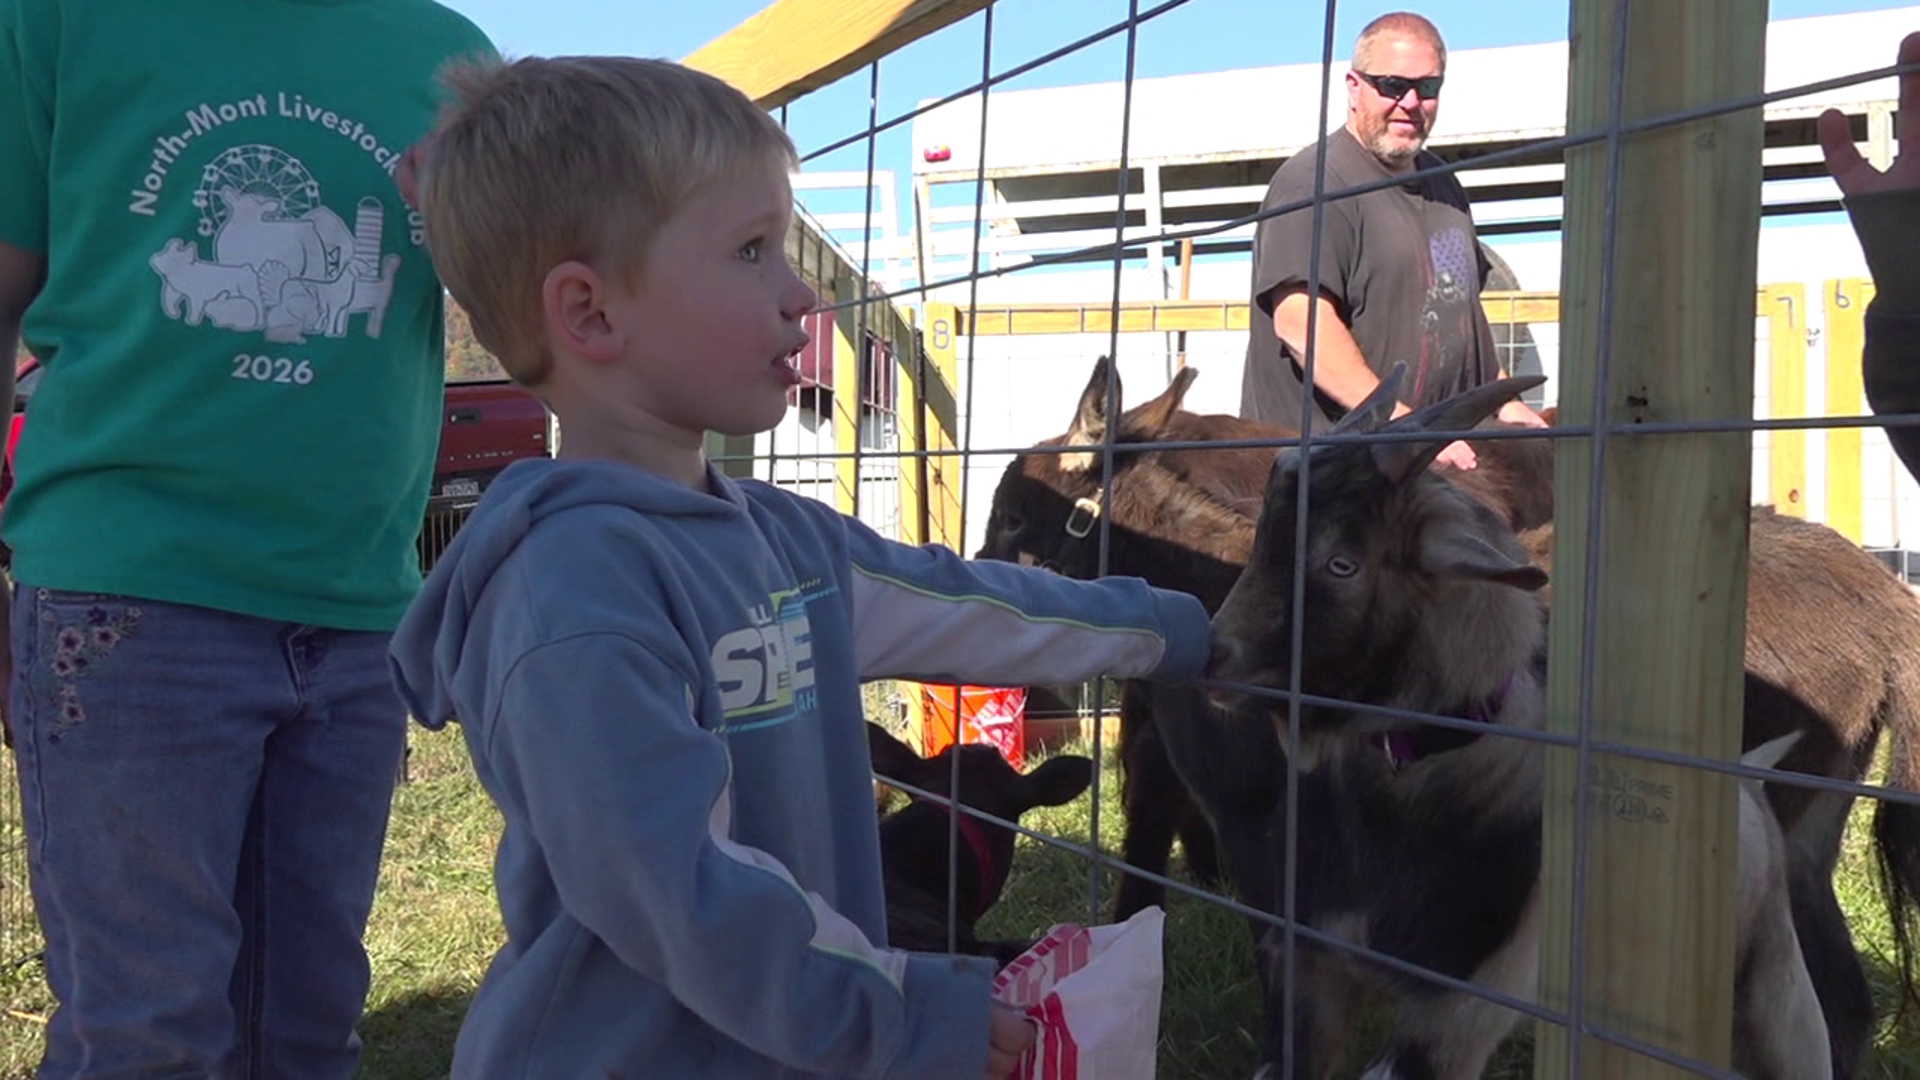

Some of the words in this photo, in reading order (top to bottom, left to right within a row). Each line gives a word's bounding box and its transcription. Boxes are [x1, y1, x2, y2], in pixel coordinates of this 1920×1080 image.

[129, 94, 268, 216] North-Mont
[278, 92, 401, 176] Livestock
[1835, 279, 1850, 309] 6
[1776, 296, 1794, 329] 7
[932, 319, 950, 350] 8
[230, 353, 315, 385] 2026
